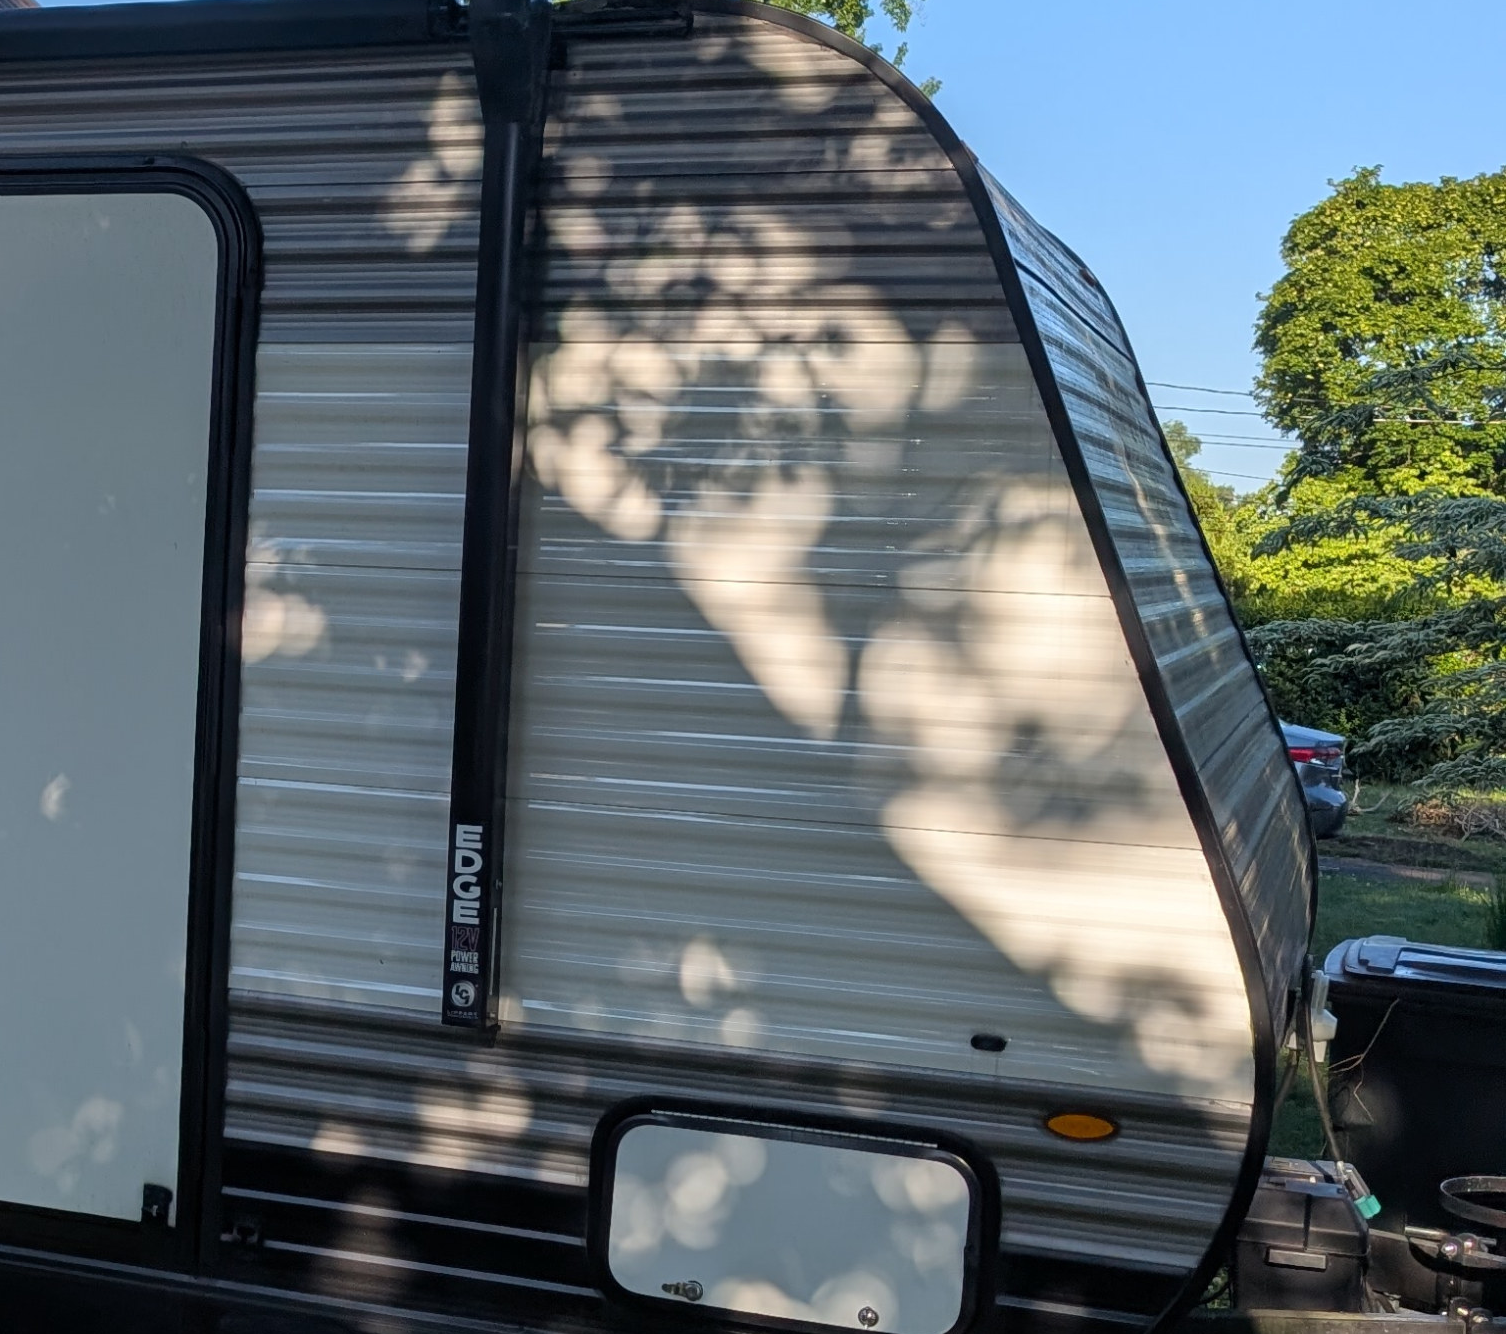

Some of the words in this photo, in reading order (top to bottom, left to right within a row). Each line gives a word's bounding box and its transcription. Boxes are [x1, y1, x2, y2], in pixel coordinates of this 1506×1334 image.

[452, 823, 483, 925] EDGE
[451, 925, 480, 952] 12V
[451, 949, 479, 963] POWER
[449, 961, 479, 974] AWNING
